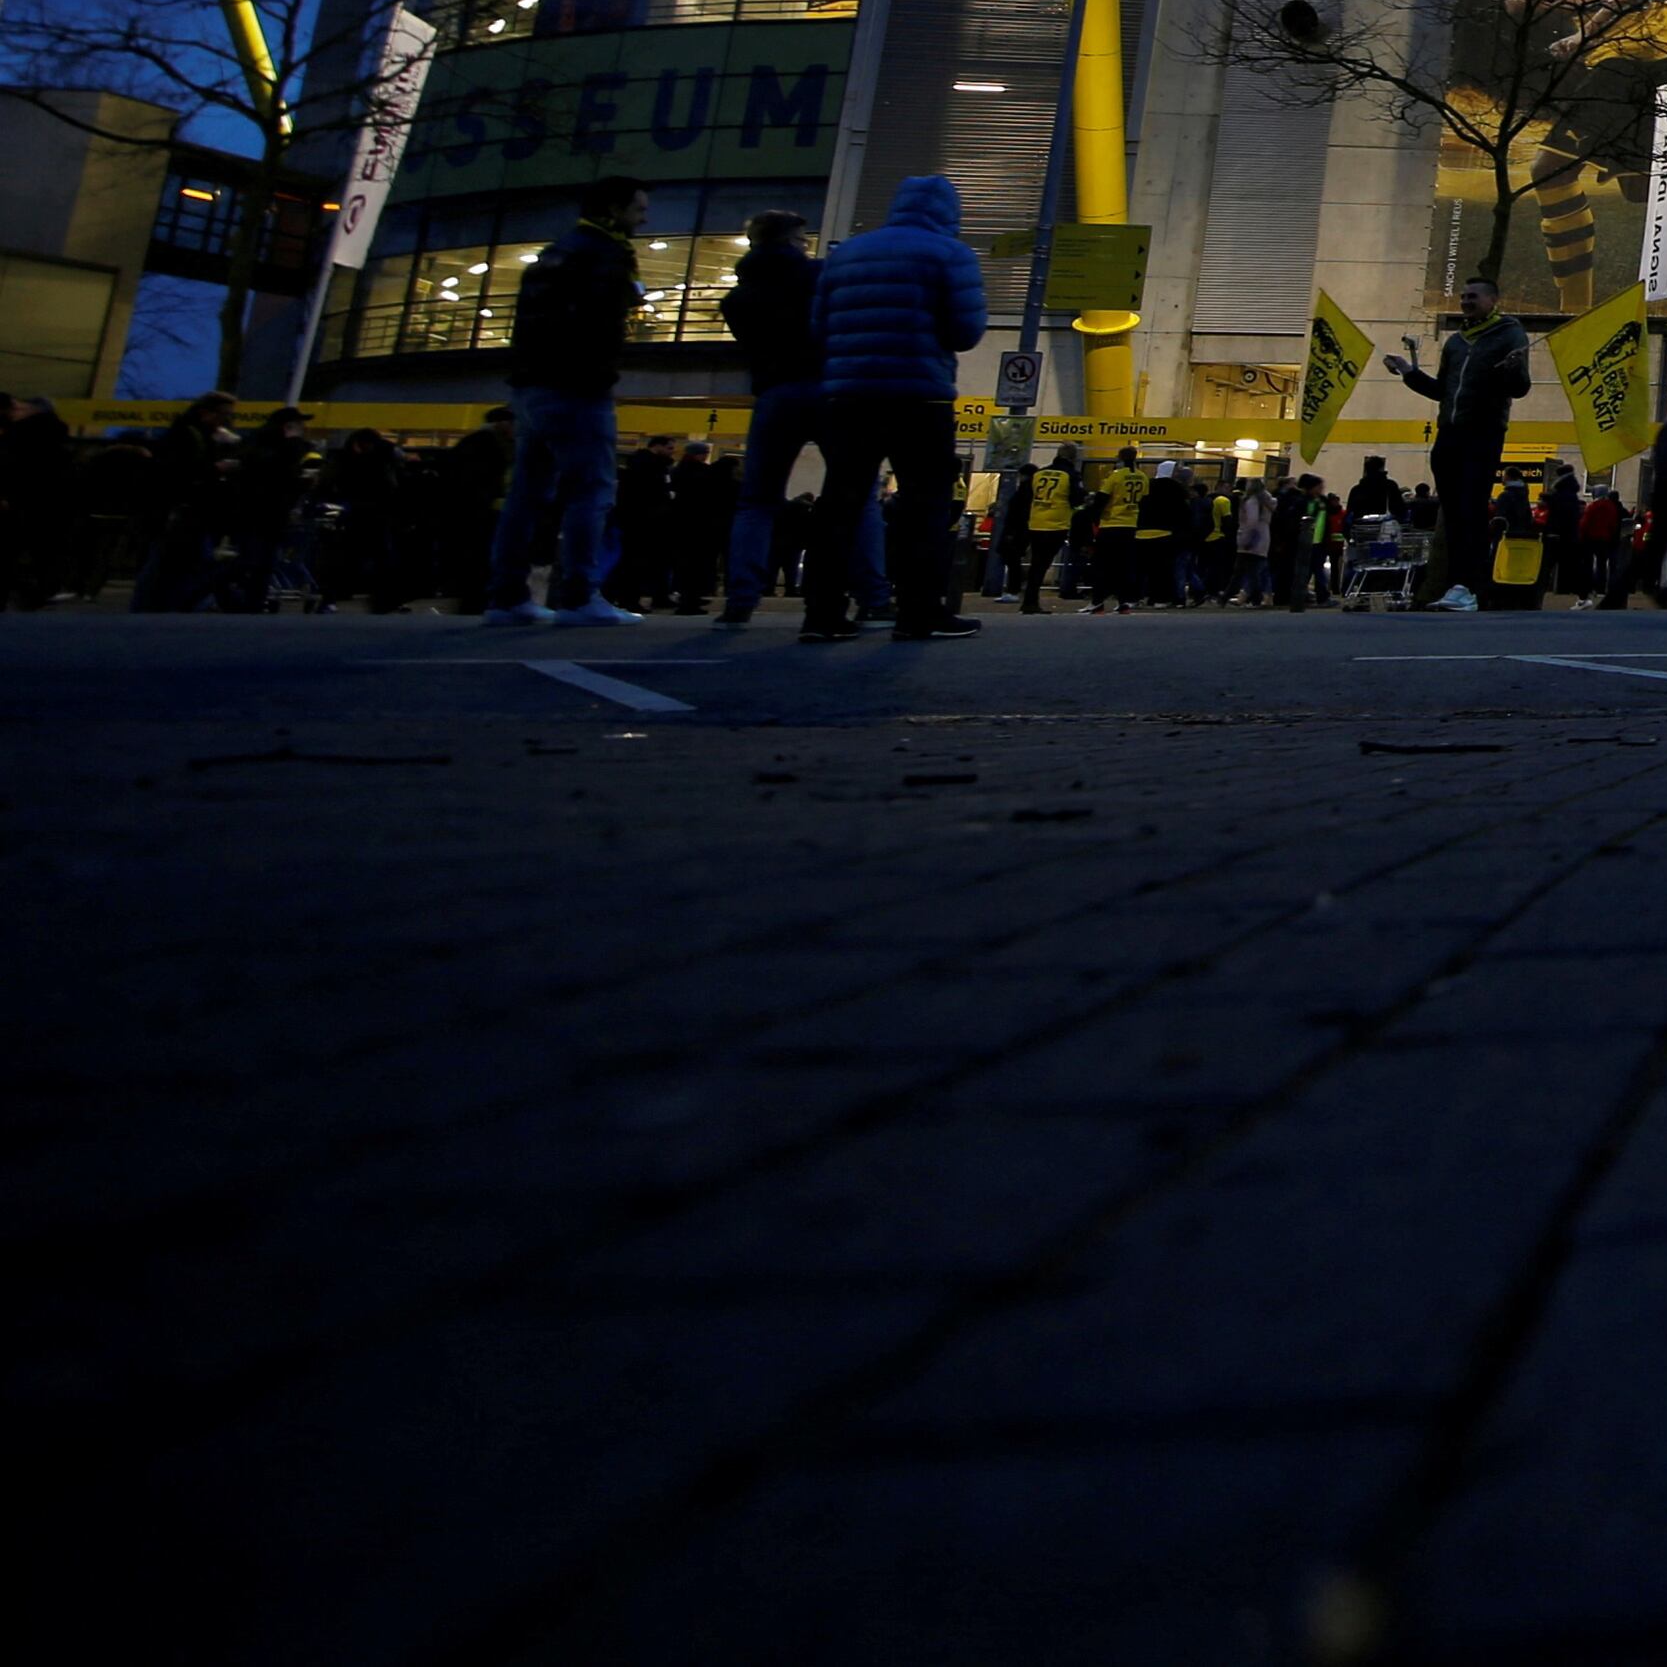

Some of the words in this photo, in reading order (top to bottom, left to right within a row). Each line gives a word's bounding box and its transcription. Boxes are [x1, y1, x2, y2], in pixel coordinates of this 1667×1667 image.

[1039, 422, 1094, 434] Südost
[1099, 422, 1167, 435] Tribünen
[1035, 478, 1060, 501] 27
[1123, 482, 1144, 503] 32
